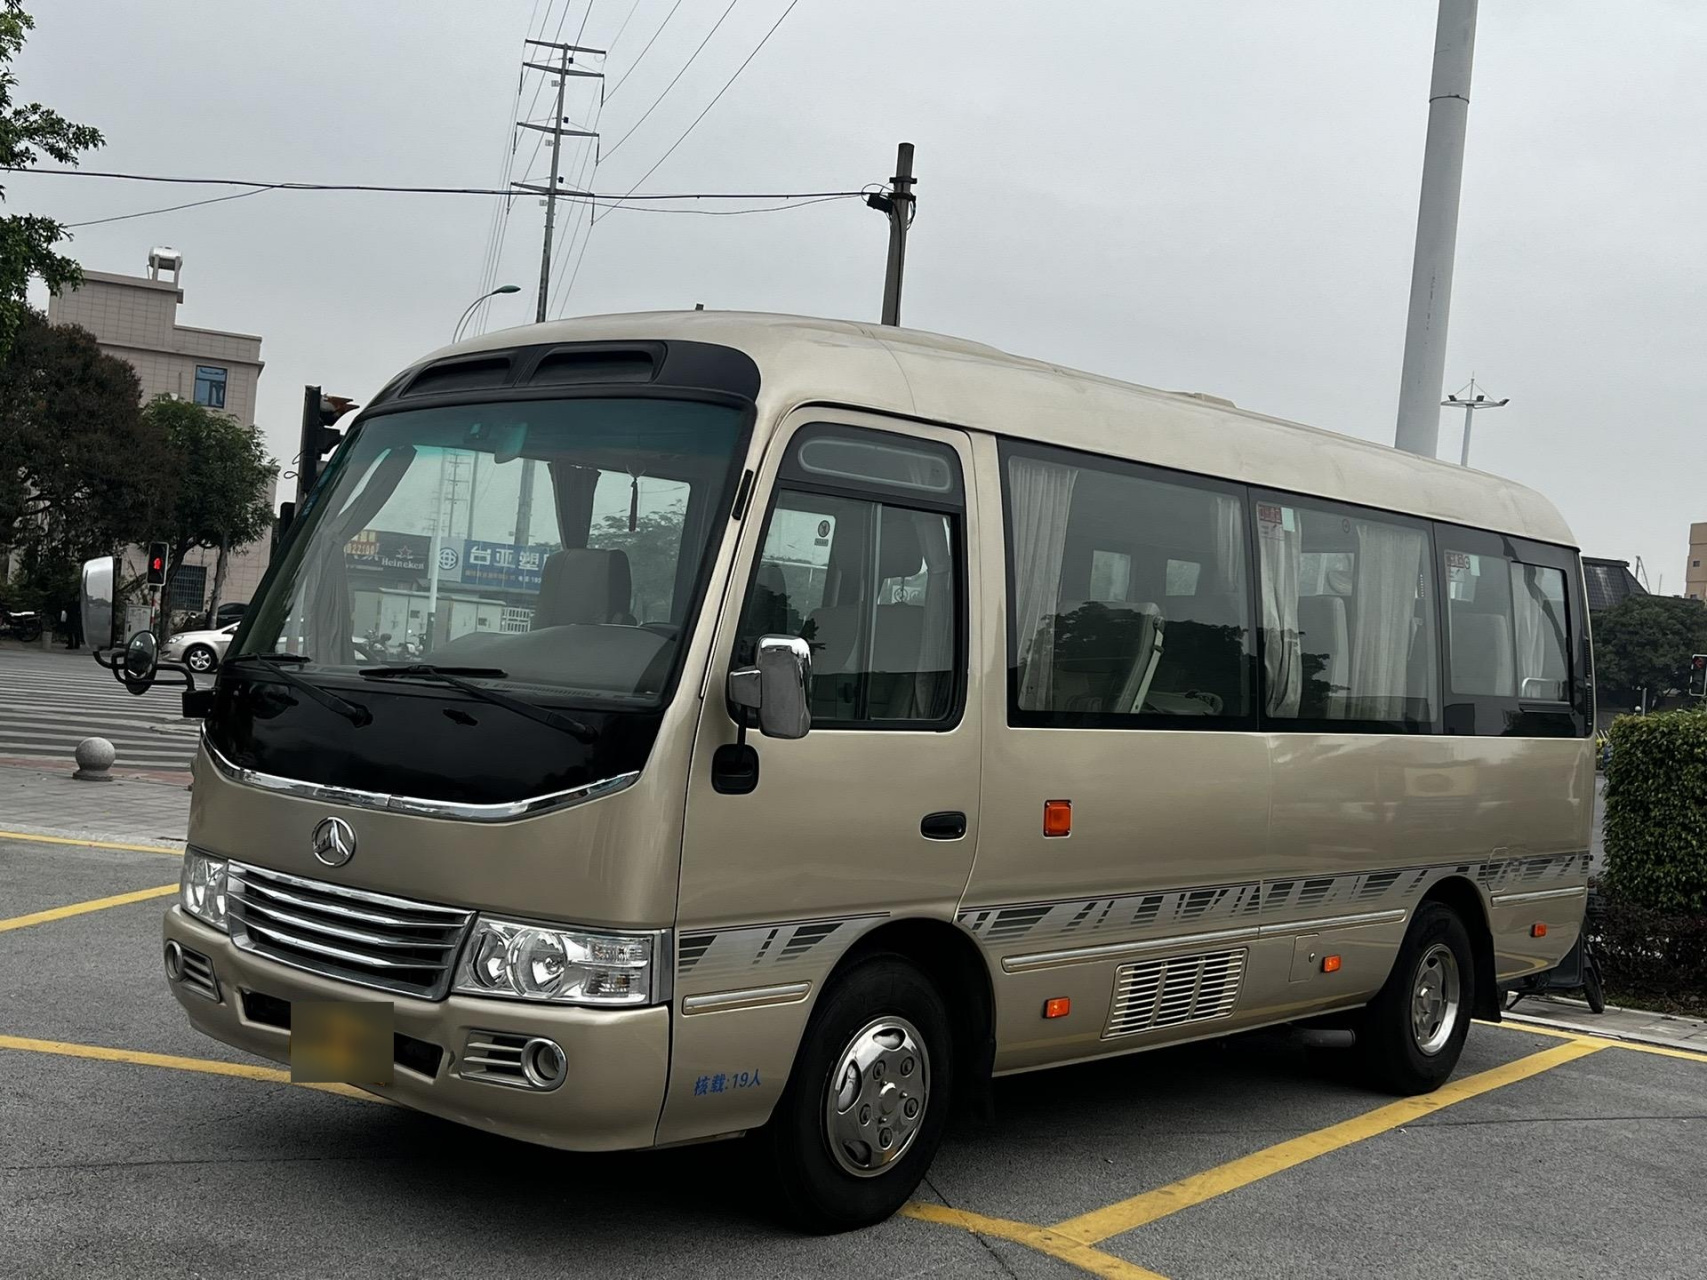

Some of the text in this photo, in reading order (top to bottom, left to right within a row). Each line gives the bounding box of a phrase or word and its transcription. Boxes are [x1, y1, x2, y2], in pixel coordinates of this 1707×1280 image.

[381, 557, 425, 570] Heineken
[469, 545, 549, 571] 台亚塑
